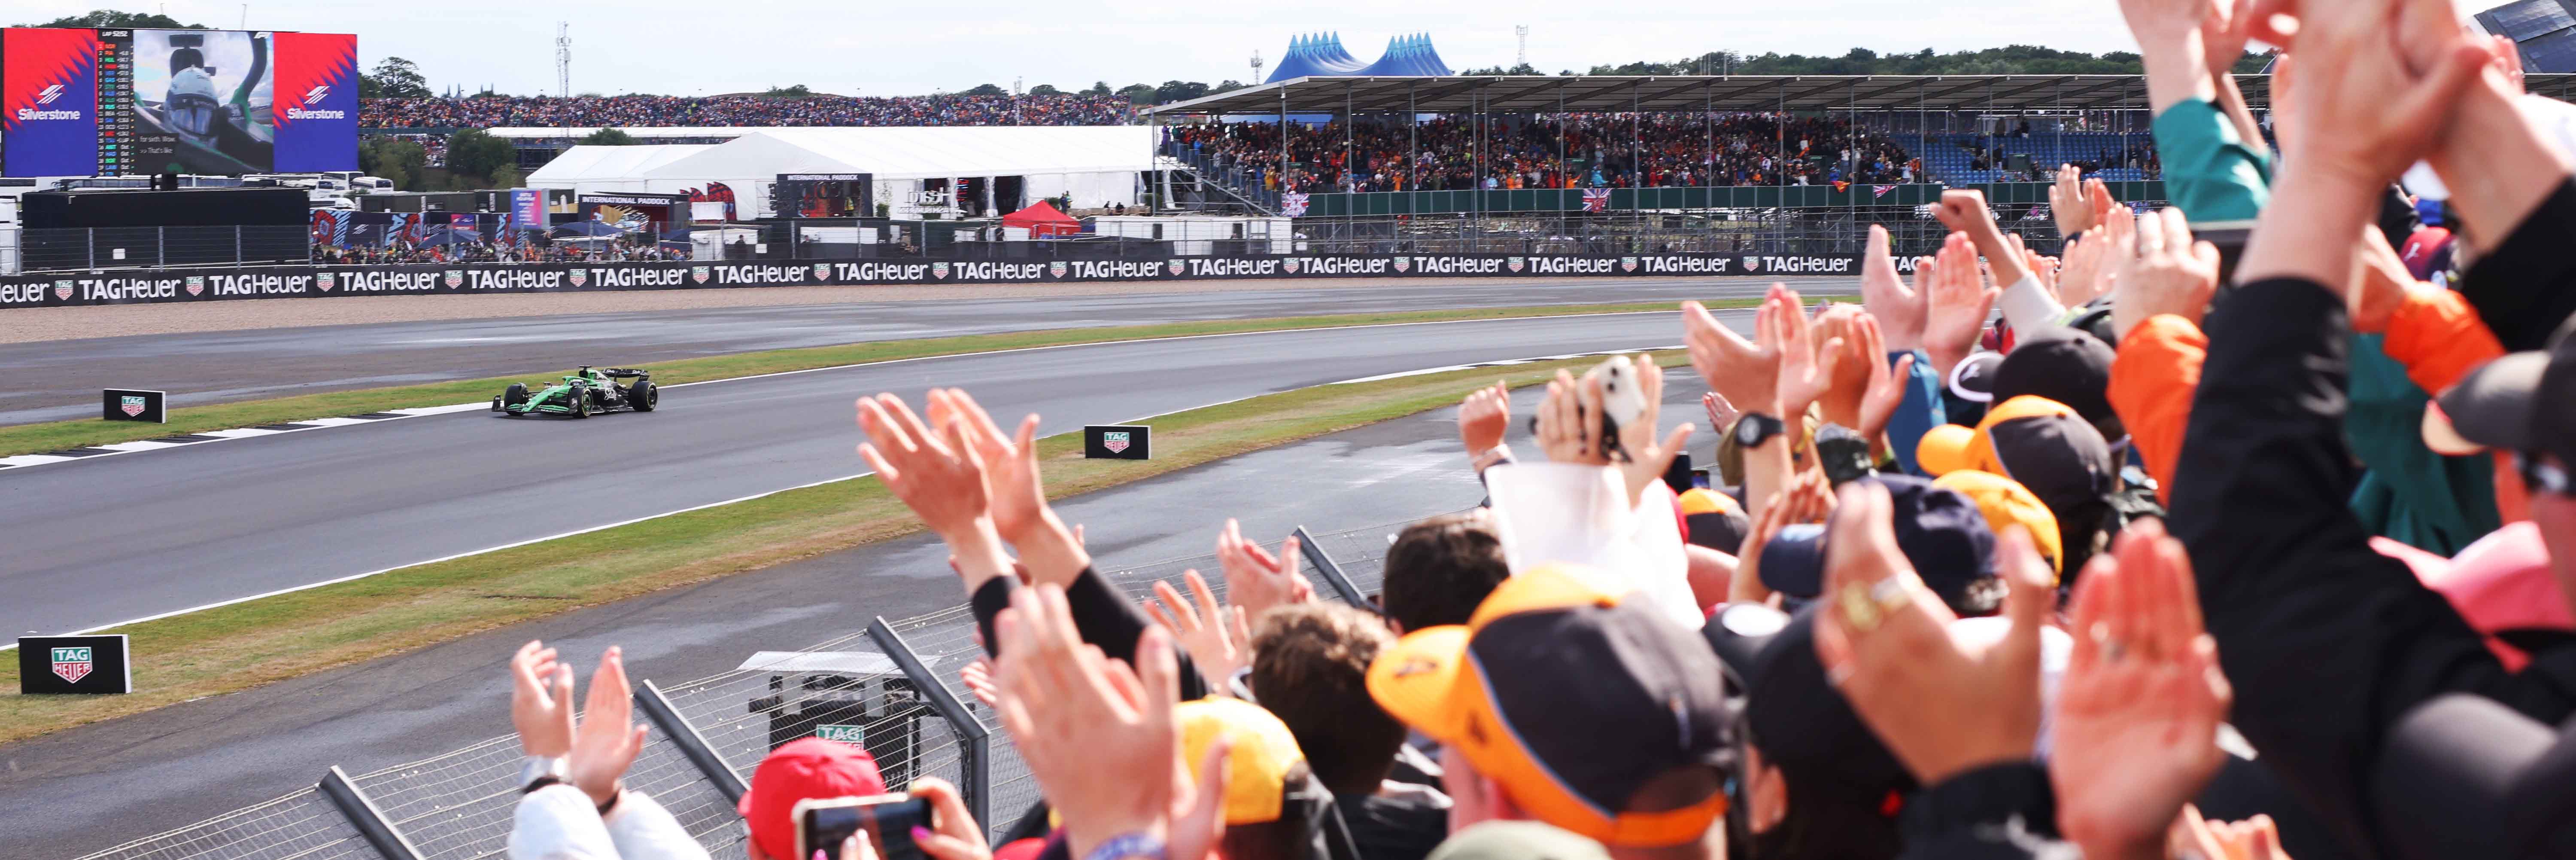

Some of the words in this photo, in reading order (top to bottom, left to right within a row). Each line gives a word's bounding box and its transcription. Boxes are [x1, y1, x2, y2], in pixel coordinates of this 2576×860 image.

[18, 109, 80, 121] Silverstone
[287, 107, 345, 119] Silverstone
[55, 650, 88, 661] TAG
[55, 662, 90, 680] HEUER
[820, 727, 860, 741] TAG
